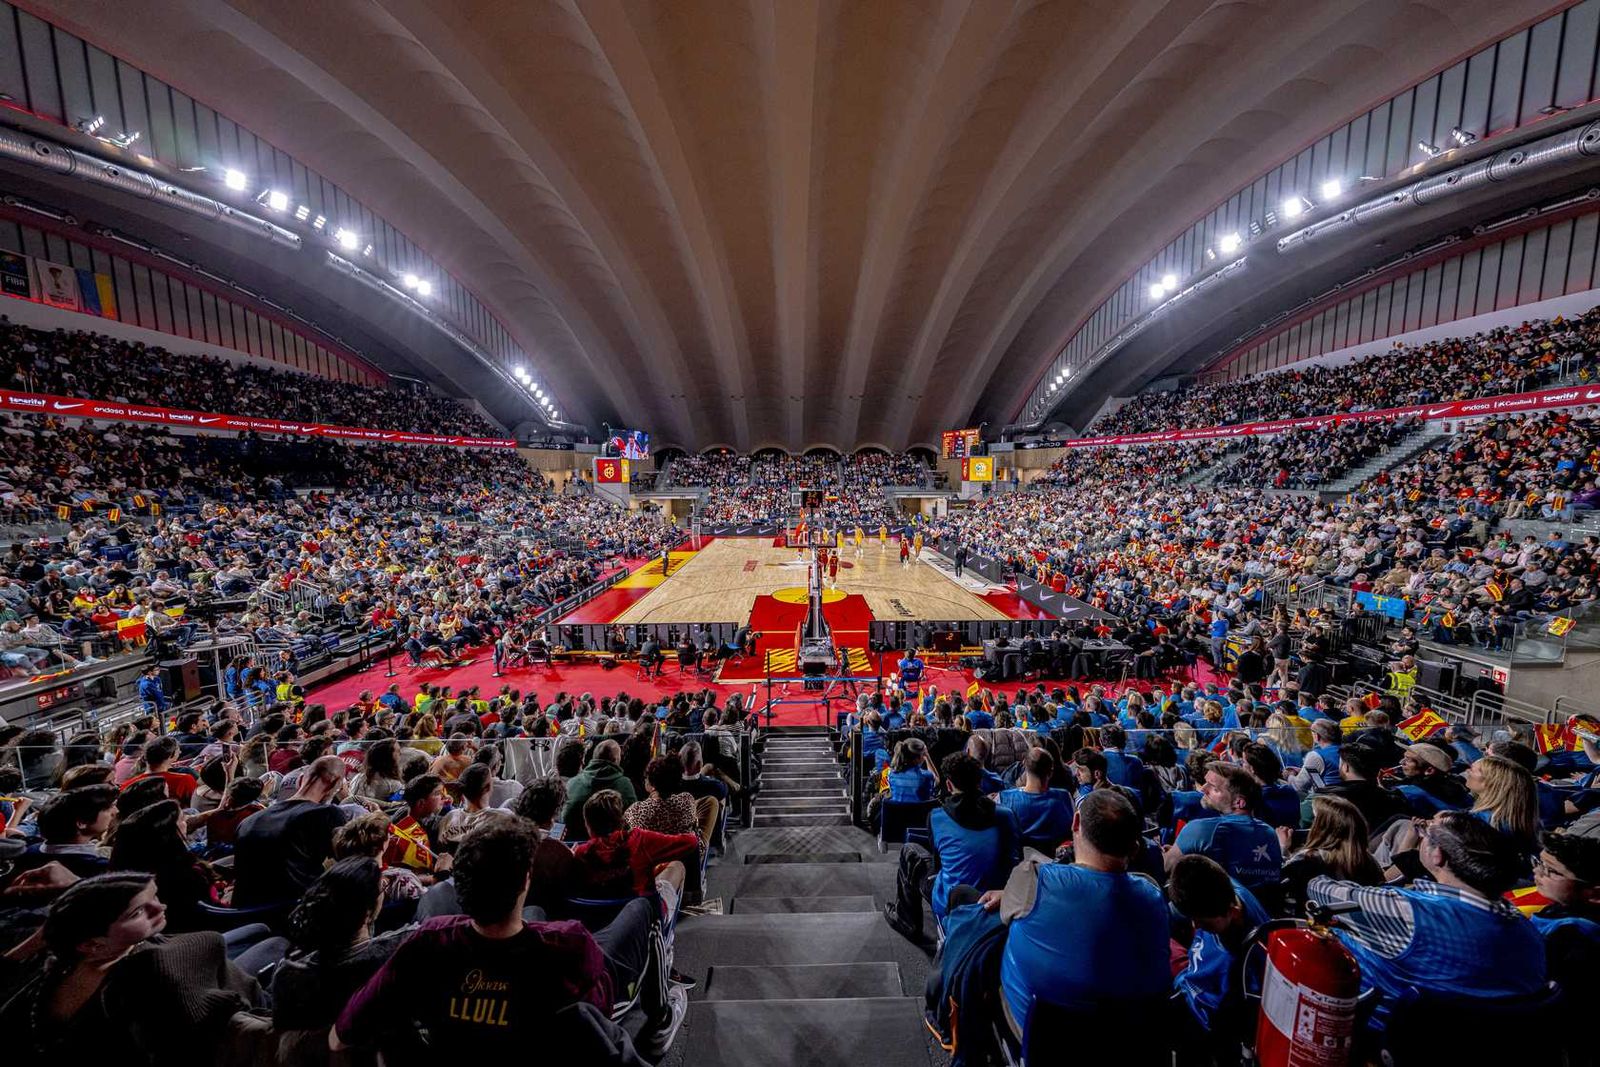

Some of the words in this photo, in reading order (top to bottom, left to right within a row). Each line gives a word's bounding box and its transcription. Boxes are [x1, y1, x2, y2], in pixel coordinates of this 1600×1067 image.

[5, 275, 26, 287] FIBA
[805, 498, 819, 507] 24
[449, 997, 509, 1026] LLULL
